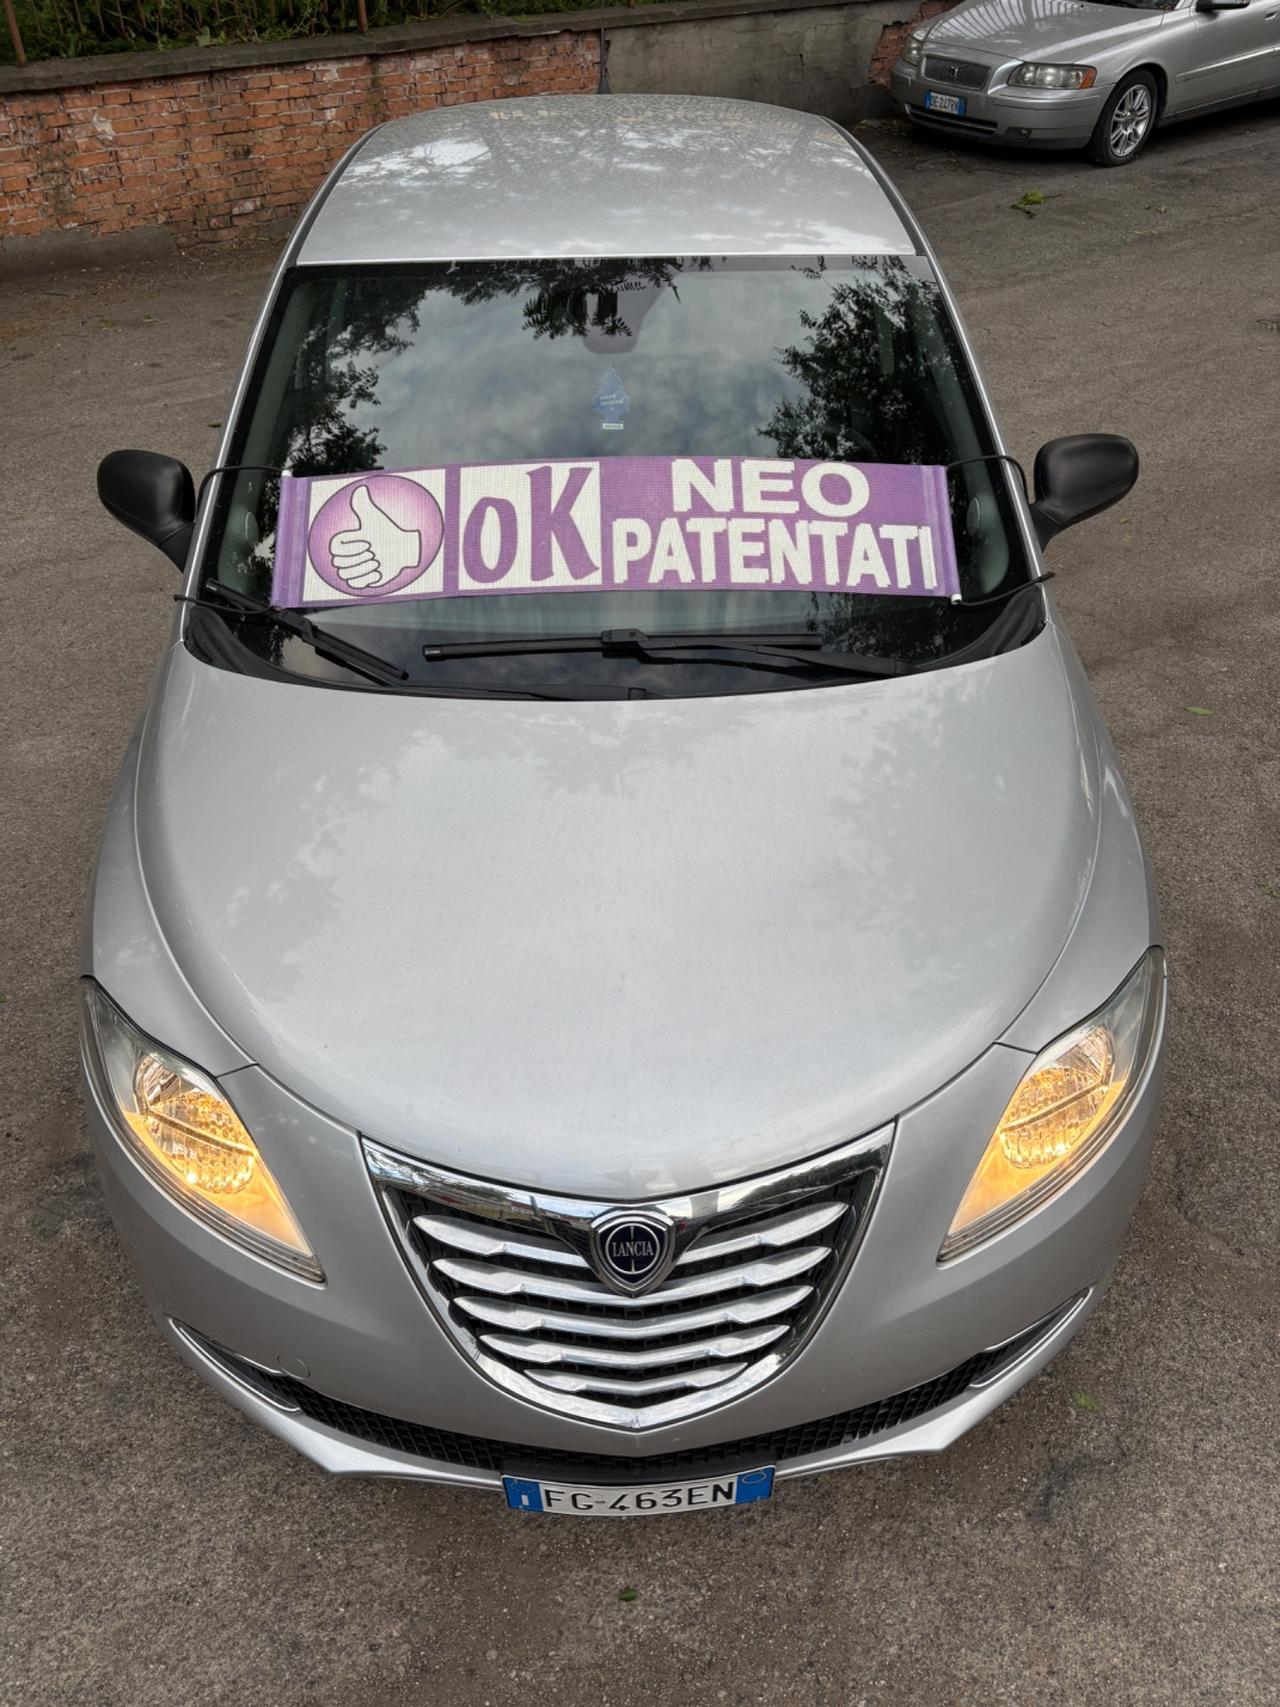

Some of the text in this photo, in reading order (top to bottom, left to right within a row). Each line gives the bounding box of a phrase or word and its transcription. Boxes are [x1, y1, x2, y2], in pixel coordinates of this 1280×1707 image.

[672, 459, 869, 517] NEO
[463, 465, 600, 583] OK
[612, 518, 937, 589] PATENTATI
[612, 1241, 654, 1257] LANCIA
